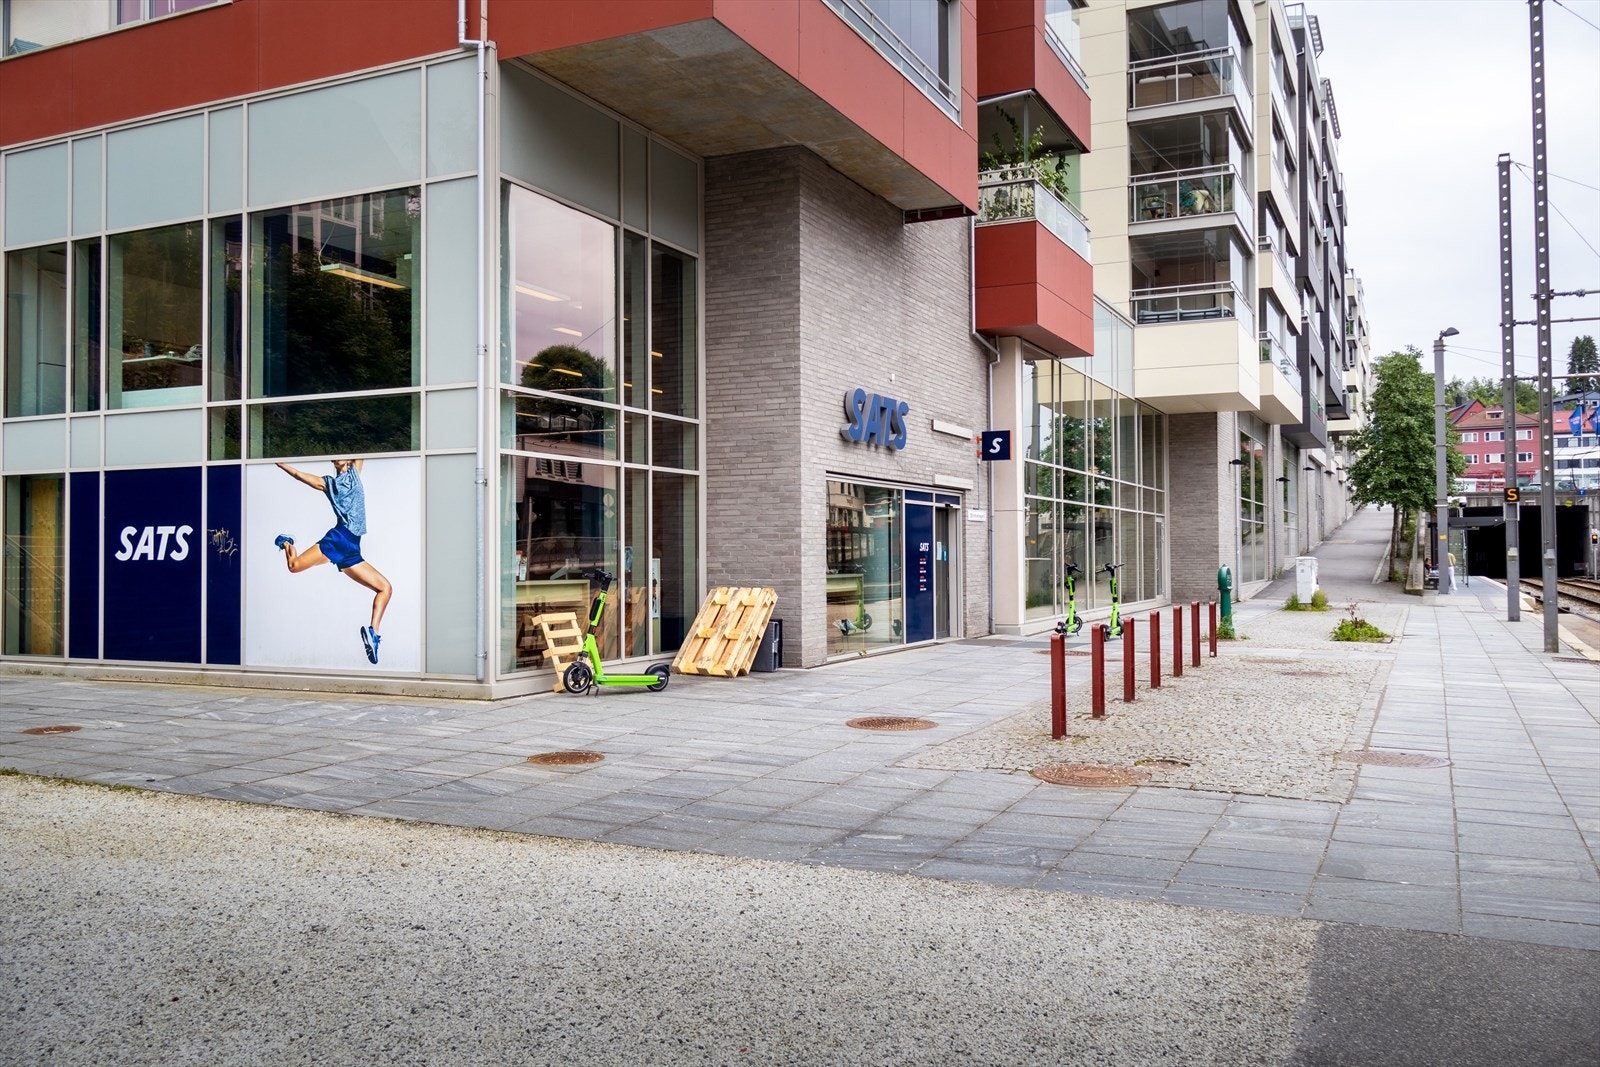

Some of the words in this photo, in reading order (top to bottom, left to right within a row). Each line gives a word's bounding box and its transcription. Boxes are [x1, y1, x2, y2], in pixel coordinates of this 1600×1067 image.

[841, 387, 910, 451] SATS
[989, 437, 1003, 454] S
[1507, 488, 1518, 501] S
[115, 525, 194, 561] SATS
[919, 542, 930, 552] SATS
